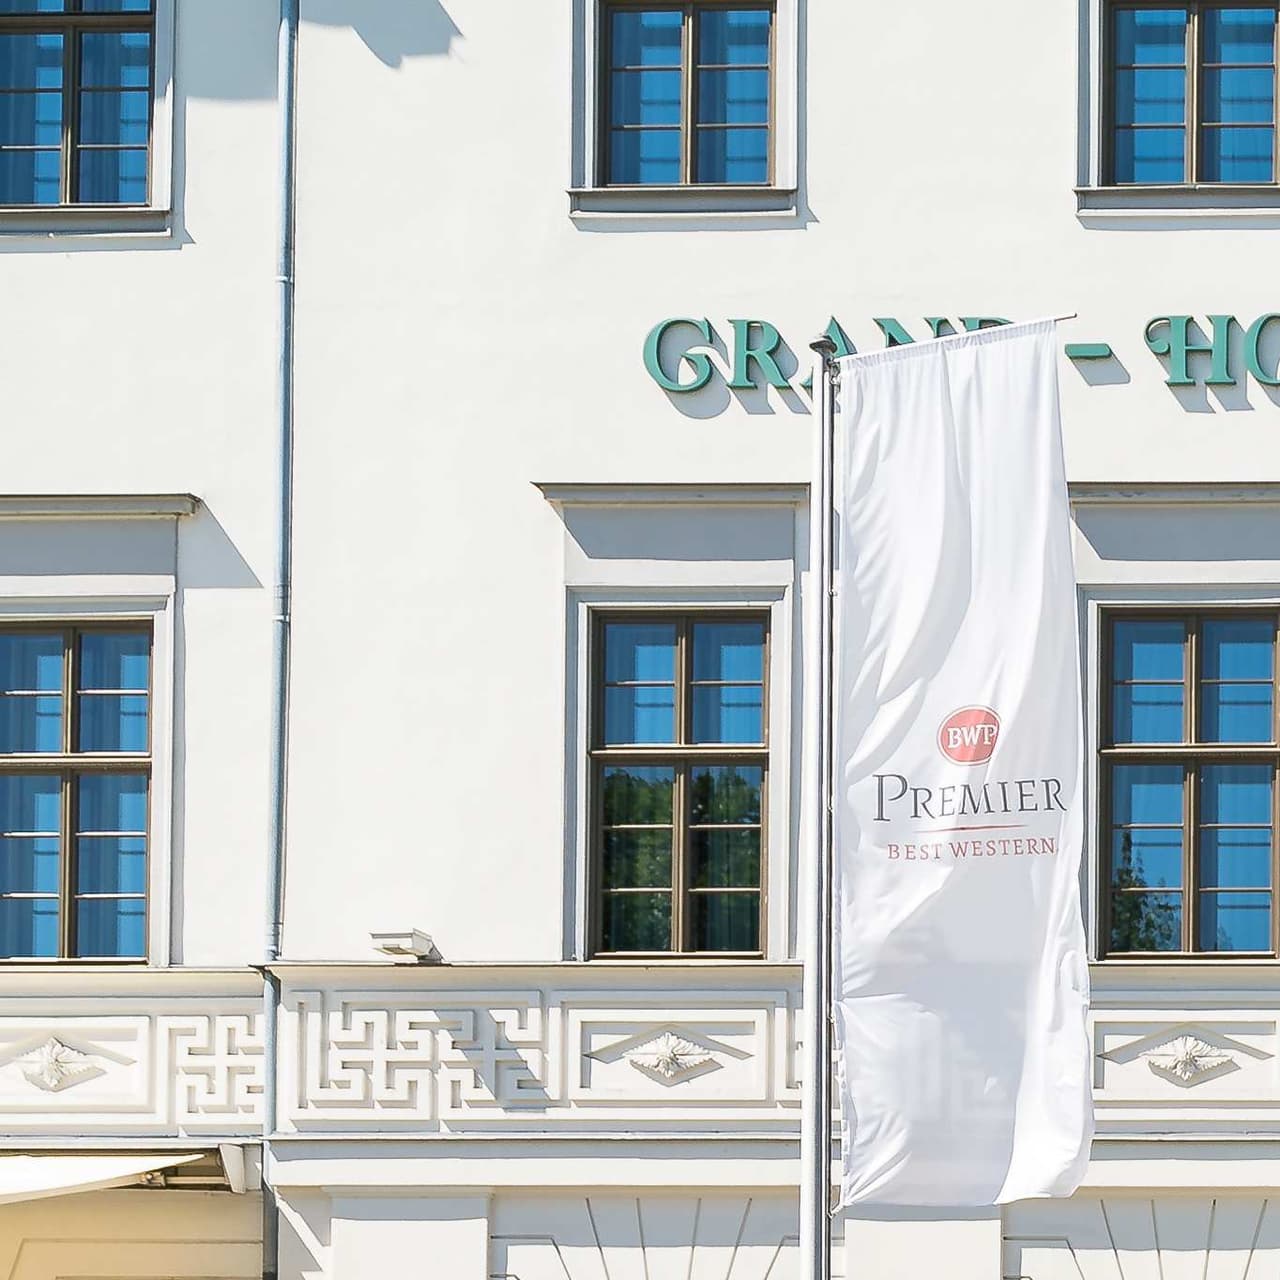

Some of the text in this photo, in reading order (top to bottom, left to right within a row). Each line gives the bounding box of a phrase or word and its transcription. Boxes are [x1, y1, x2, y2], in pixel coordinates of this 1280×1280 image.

[946, 723, 997, 749] BWP
[872, 773, 1068, 822] PREMIER
[887, 837, 1056, 861] BEST WESTERN
